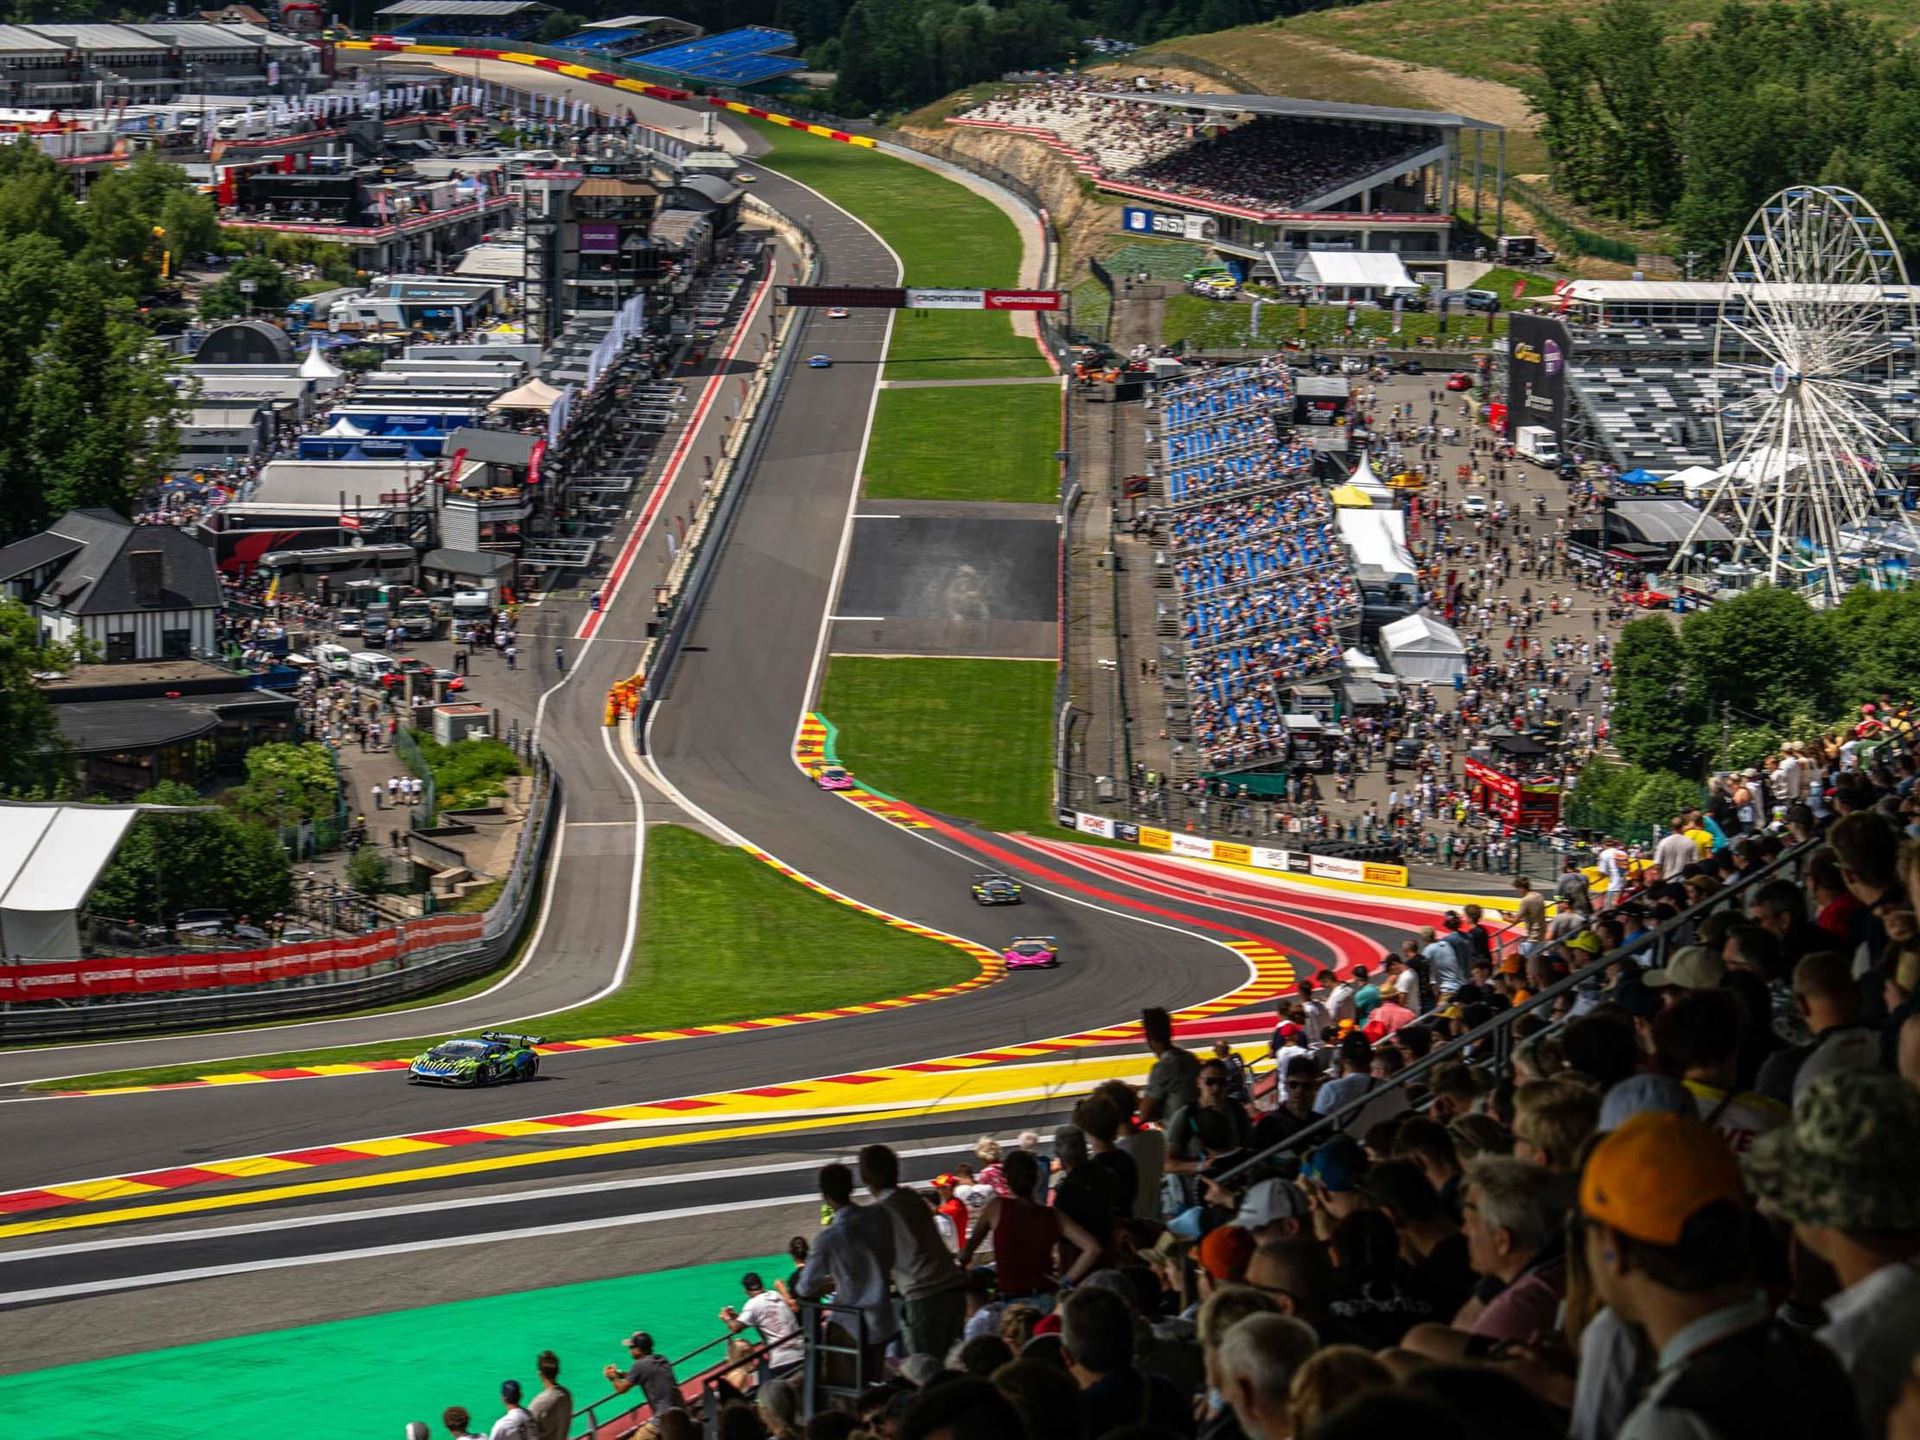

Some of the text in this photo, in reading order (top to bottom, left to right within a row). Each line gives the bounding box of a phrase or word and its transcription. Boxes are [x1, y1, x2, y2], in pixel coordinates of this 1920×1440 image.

[914, 294, 981, 303] CROWDSTRIKE
[992, 296, 1056, 304] CROWDSTRIKE
[1364, 867, 1403, 883] PIRELLI
